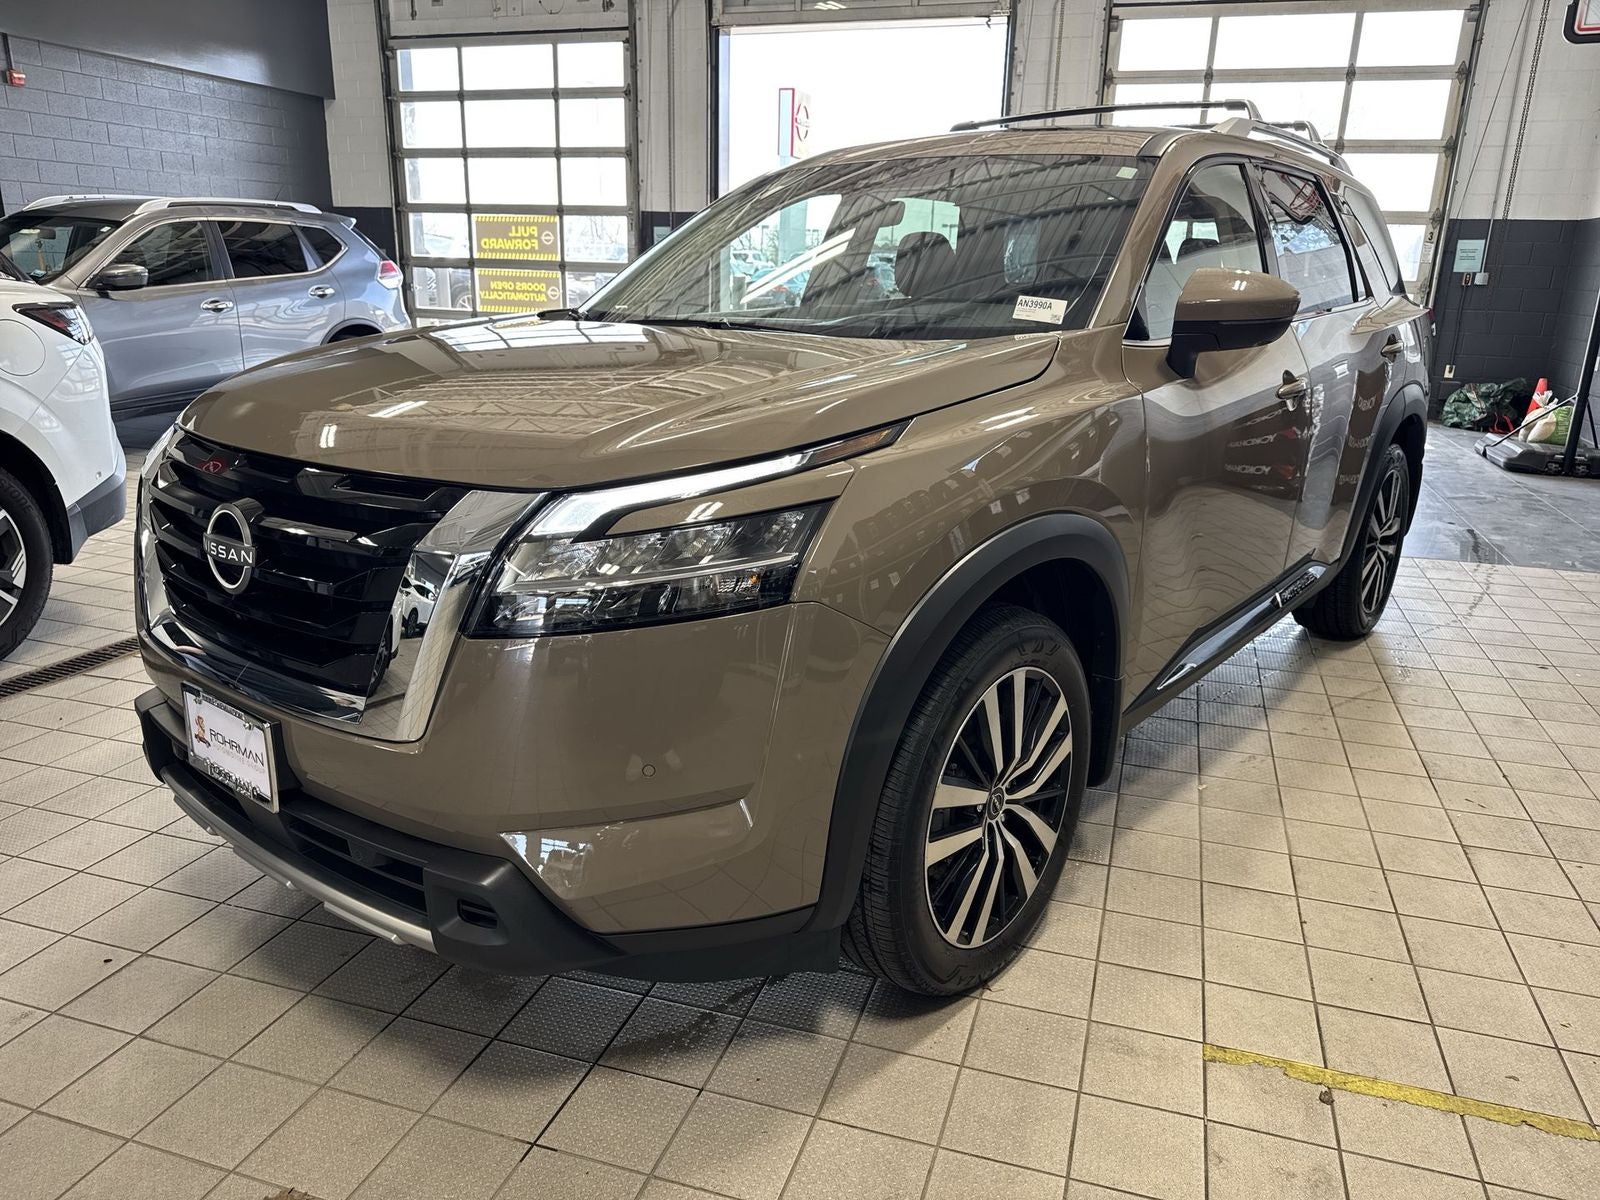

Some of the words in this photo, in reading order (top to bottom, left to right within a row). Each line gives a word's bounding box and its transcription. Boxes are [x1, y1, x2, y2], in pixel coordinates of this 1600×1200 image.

[1428, 231, 1434, 241] 3
[1017, 299, 1053, 310] AN3990A
[209, 728, 265, 767] ROHRMAN
